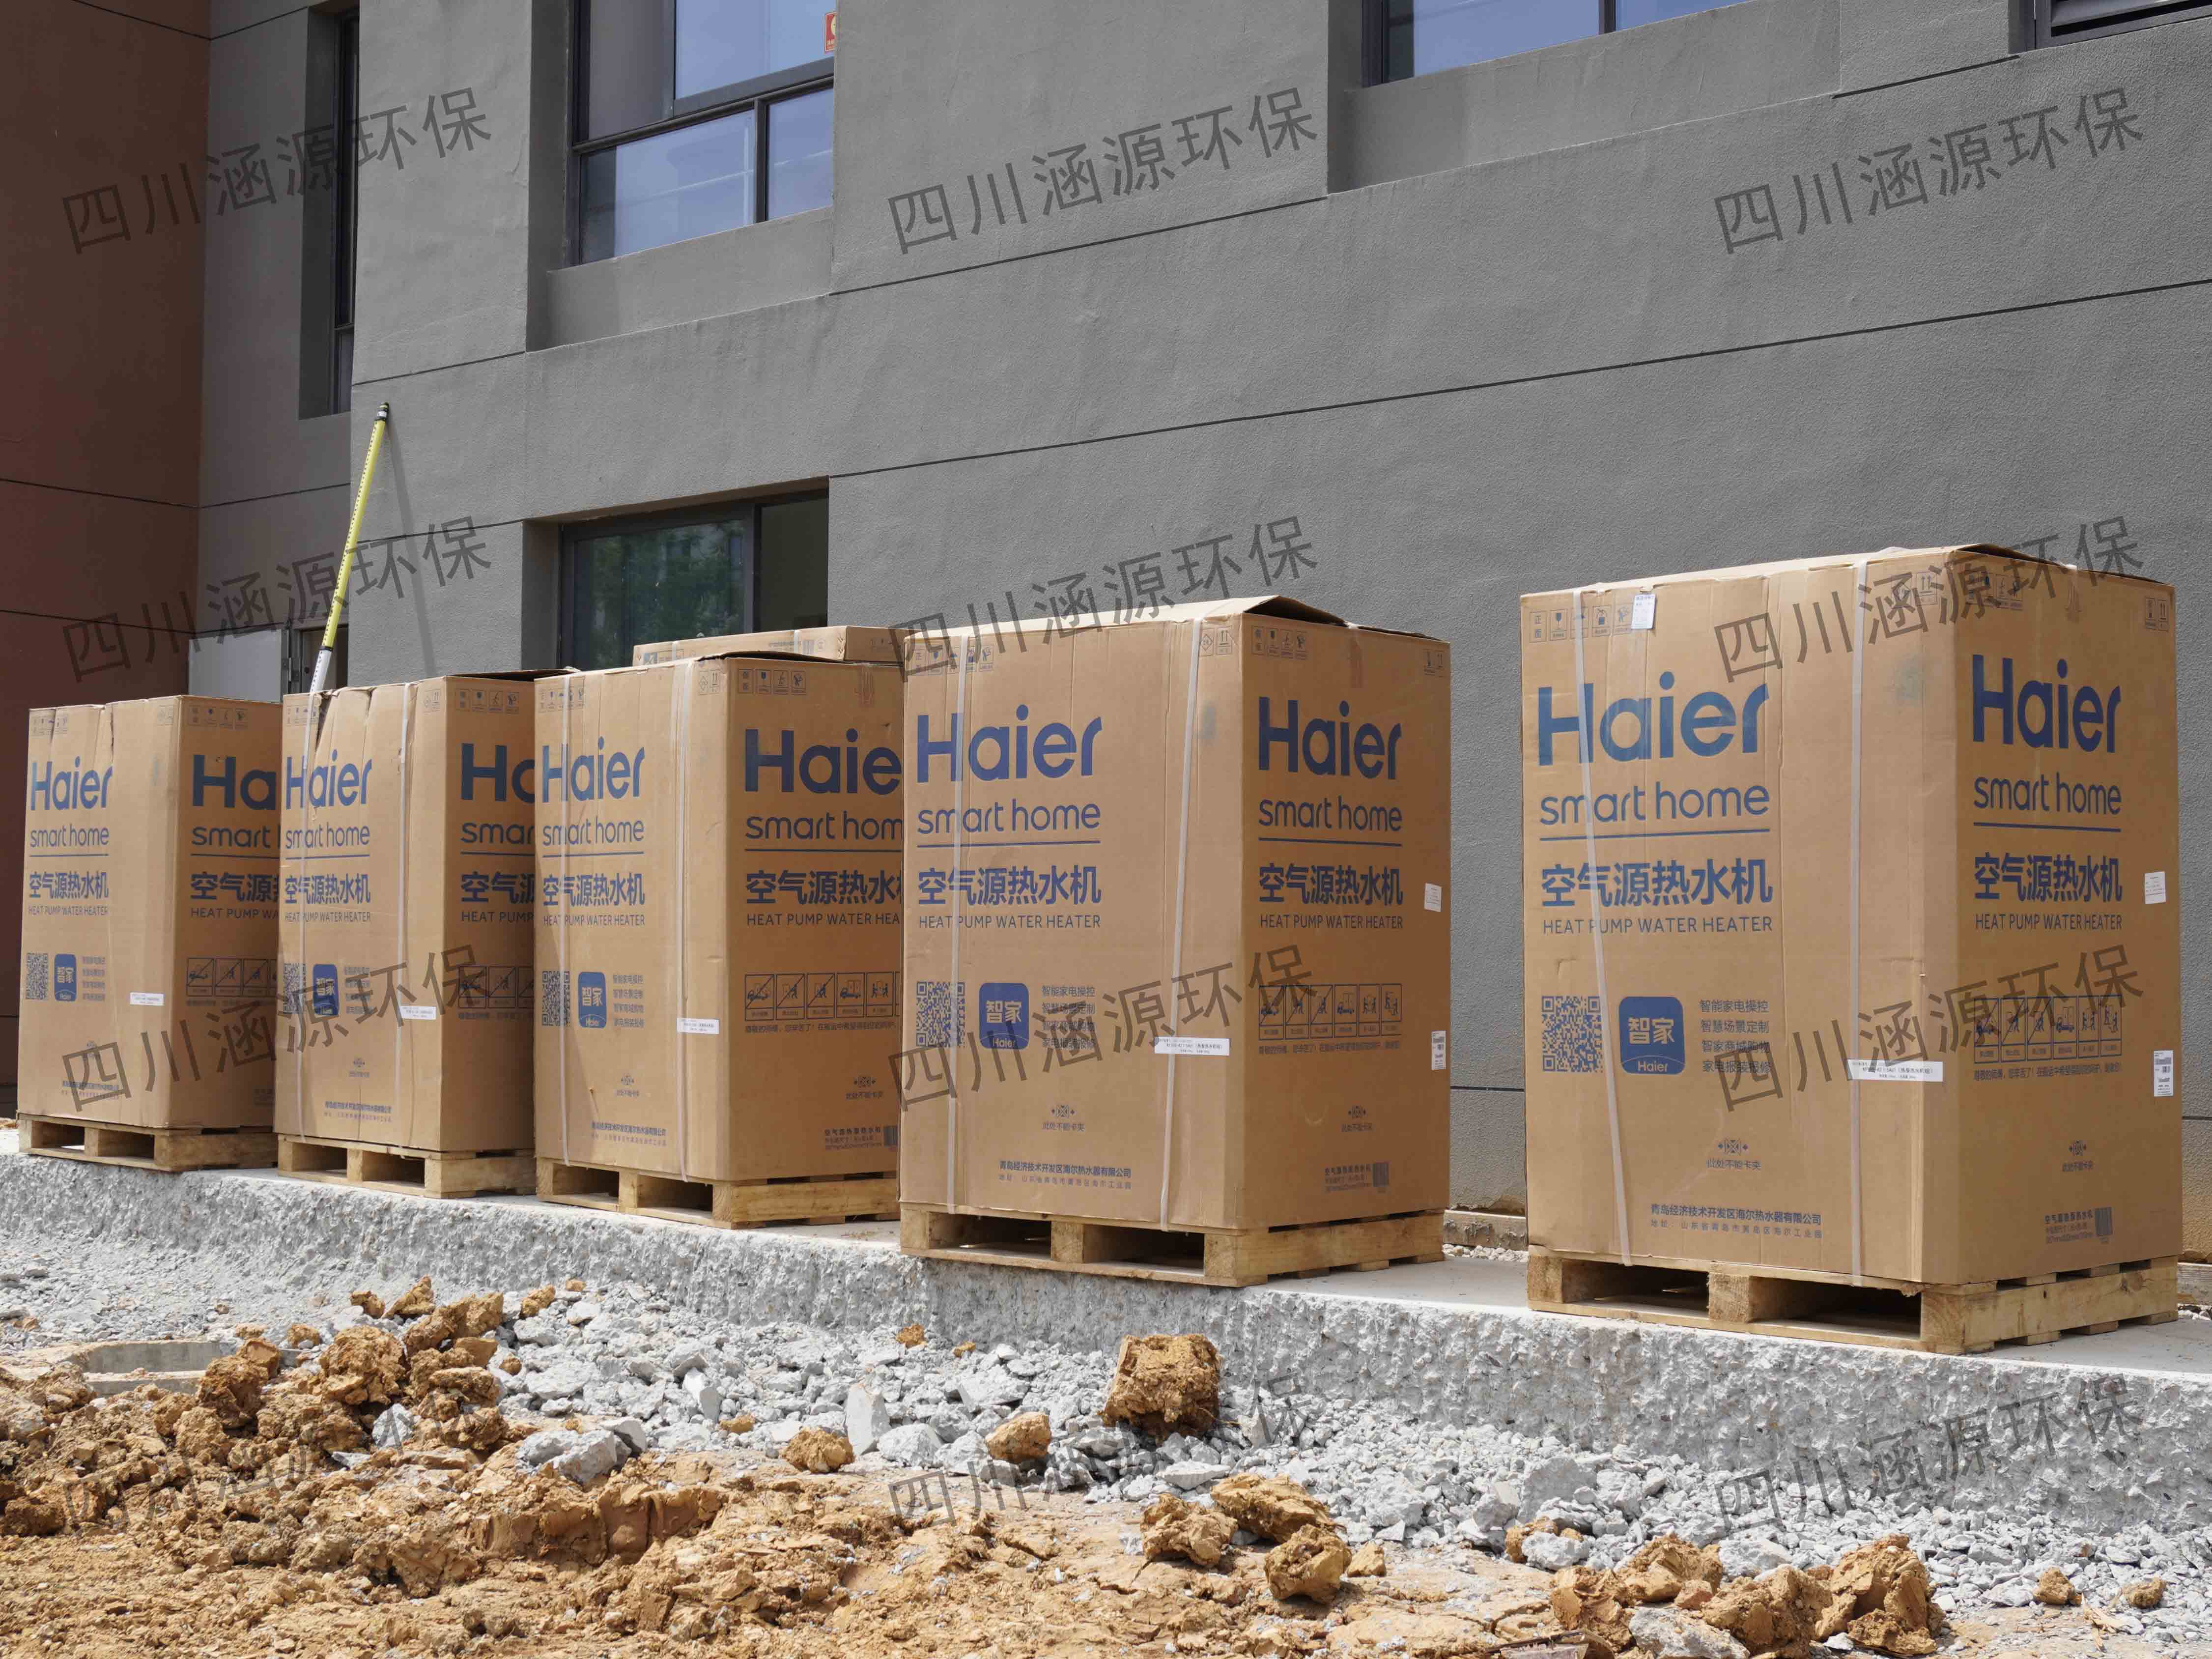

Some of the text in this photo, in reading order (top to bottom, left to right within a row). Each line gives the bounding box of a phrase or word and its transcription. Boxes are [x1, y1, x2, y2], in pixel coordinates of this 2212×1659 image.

[1538, 671, 1769, 766] Haier
[1973, 655, 2121, 753] Haier
[917, 705, 1102, 783] Haier
[1259, 696, 1402, 780] Haier
[30, 756, 113, 810] Haier
[285, 749, 372, 810] Haier
[542, 737, 645, 803] Haier
[1540, 782, 1770, 826] smart home
[1974, 772, 2122, 814] smart home
[746, 811, 835, 841] smart
[917, 799, 1101, 834] smart home
[1259, 795, 1402, 832] smart home
[30, 824, 109, 848] smart home
[192, 826, 270, 849] smart
[286, 824, 322, 850] smart
[327, 822, 370, 846] home
[542, 816, 644, 846] smart home
[29, 871, 109, 899] 空气源热水机
[285, 874, 371, 905] 空气源热水机
[543, 873, 645, 906] 空气源热水机
[746, 870, 902, 905] 空气源热水
[919, 864, 1102, 906] 空气源热水机
[1259, 863, 1403, 906] 空气源热水机
[1542, 858, 1773, 908] 空气源热水机
[1974, 852, 2123, 902] 空气源热水机
[191, 908, 222, 918] HEAT
[227, 908, 258, 919] PUMP
[319, 912, 342, 922] WATER
[344, 912, 370, 922] HEATER
[461, 912, 495, 922] HEAT
[565, 915, 585, 926] PUMP
[587, 915, 612, 926] WATER
[614, 914, 645, 926] HEATER
[747, 913, 782, 926] HEAT
[787, 913, 822, 926] PUMP
[826, 913, 872, 925] WATER
[919, 915, 1101, 928] HEAT PUMP WATER HEATER
[1260, 915, 1403, 928] HEAT PUMP WATER HEATER
[1543, 916, 1772, 935] HEAT PUMP WATER HEATER
[1976, 914, 2123, 930] HEAT PUMP WATER HEATER
[582, 987, 602, 1006] 智家
[1700, 999, 1769, 1013] 智能家电操控
[986, 1001, 1022, 1024] 智家
[1701, 1019, 1769, 1034] 智慧场景定制
[1628, 1017, 1675, 1045] 智家
[1637, 1061, 1668, 1072] Haier
[1650, 1203, 1821, 1226] 青岛经济技术开发区海尔热水器有限公司
